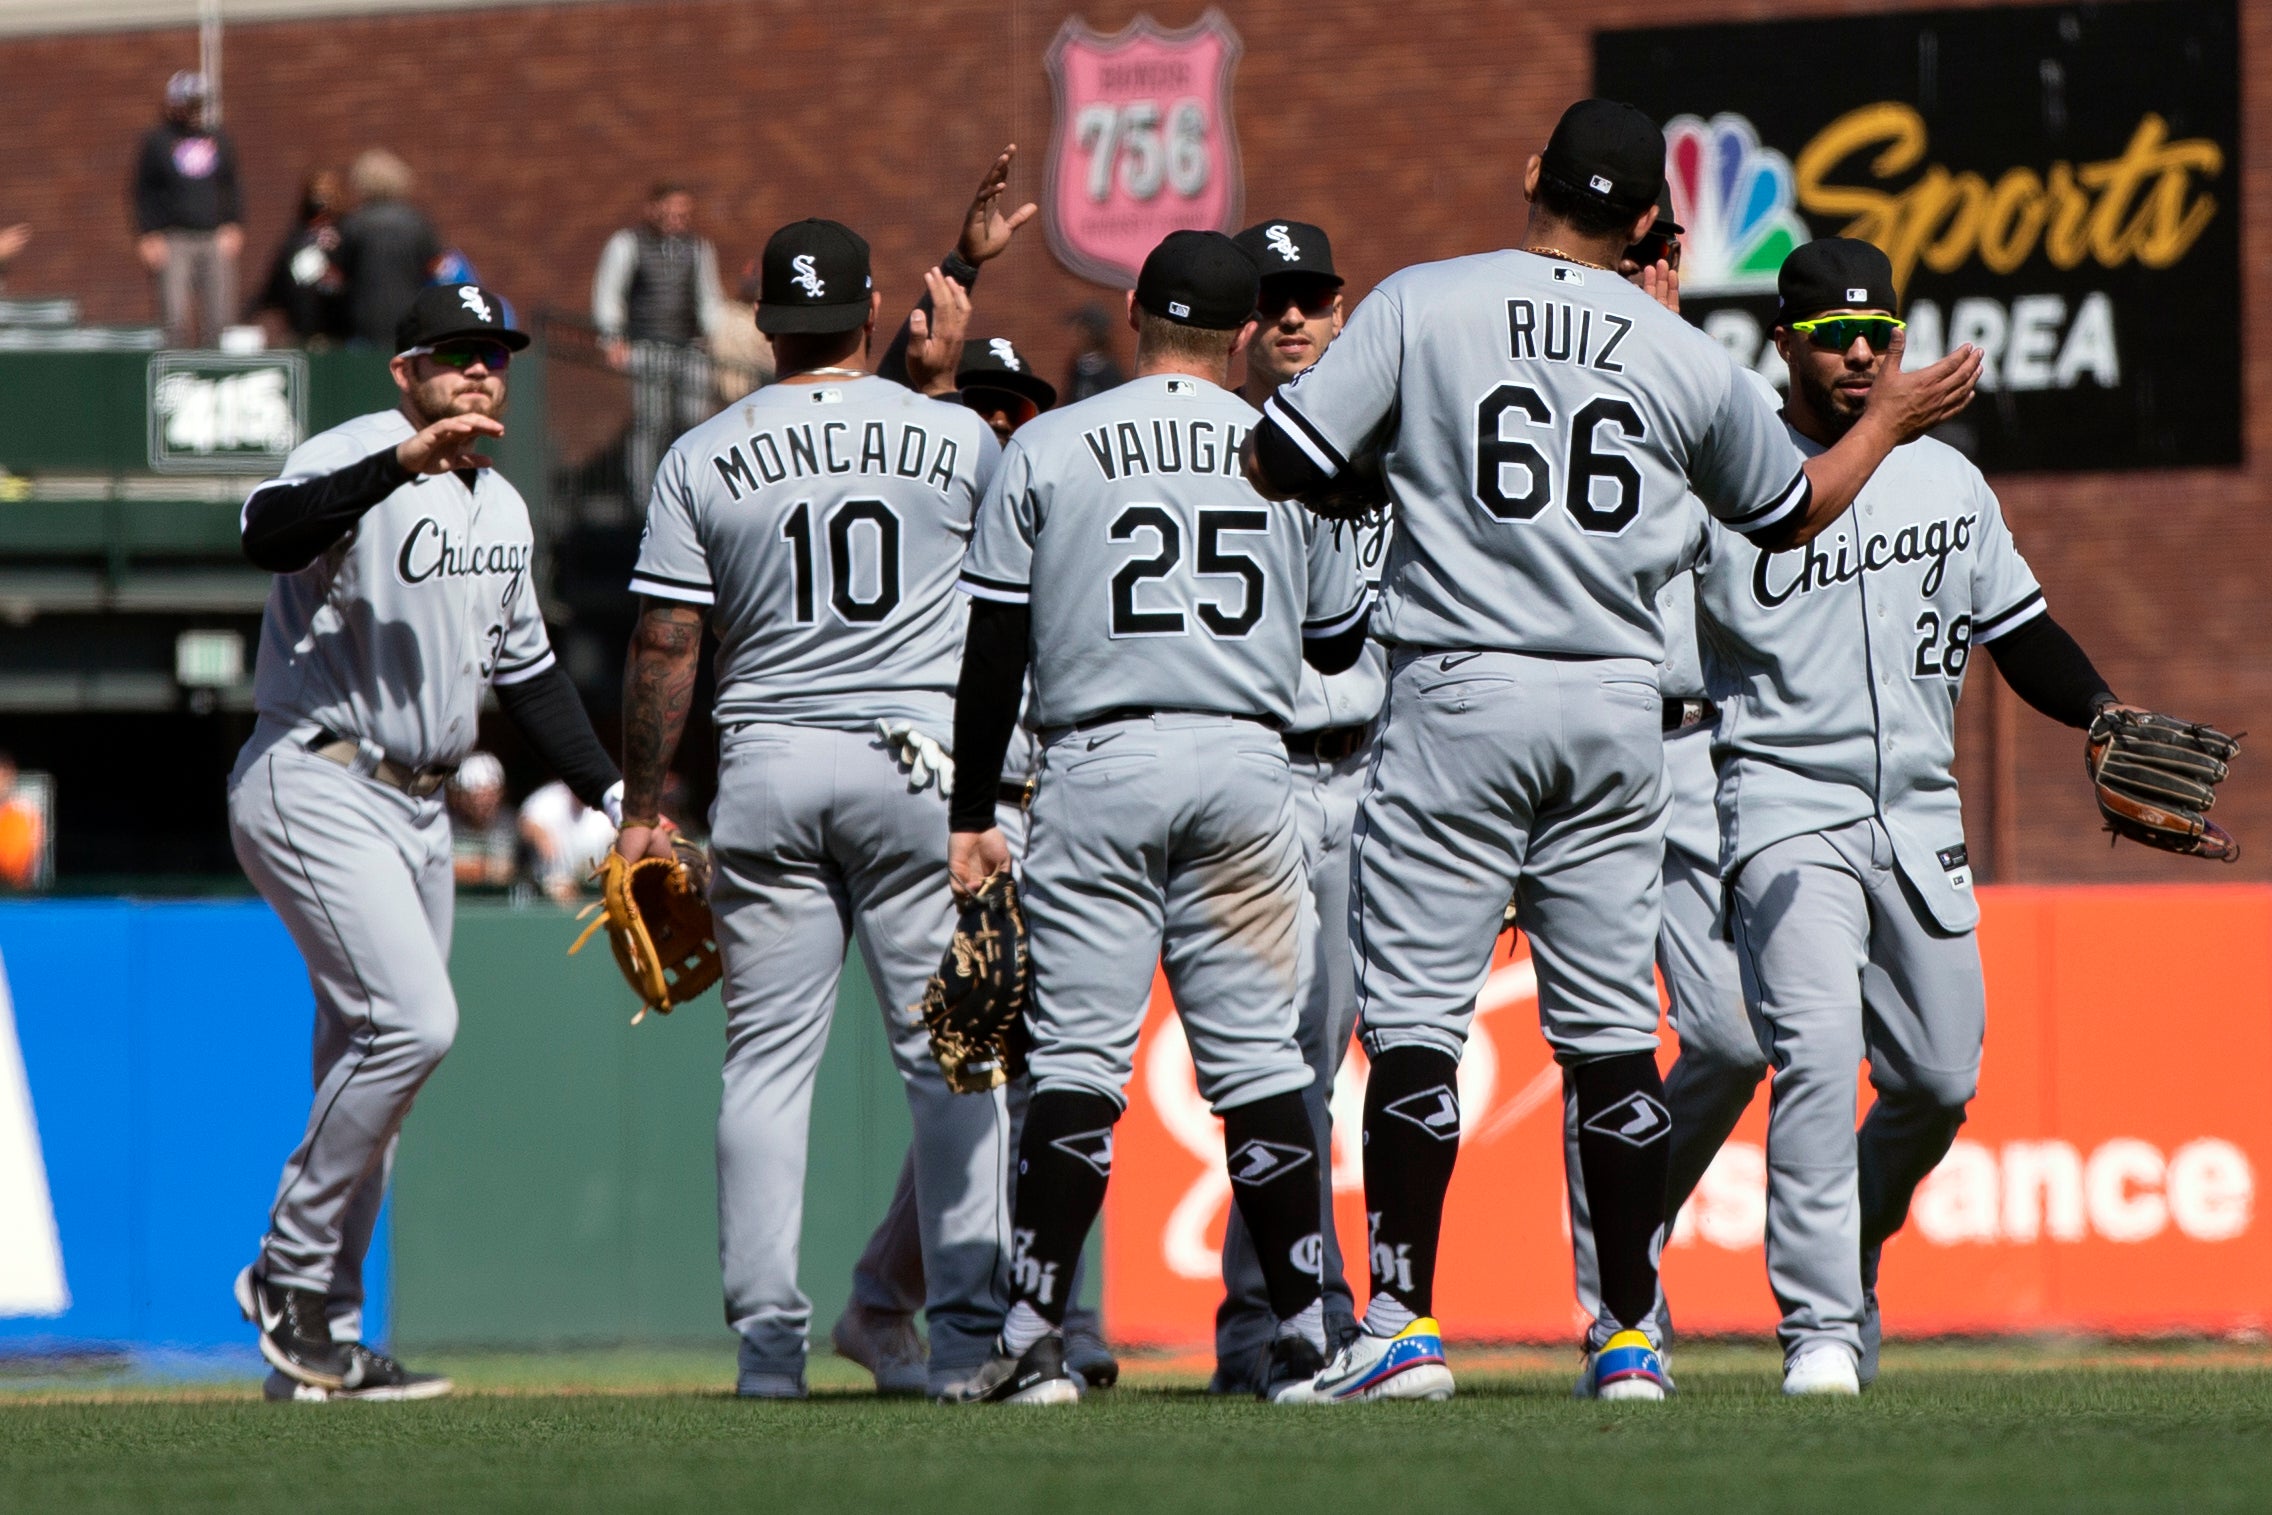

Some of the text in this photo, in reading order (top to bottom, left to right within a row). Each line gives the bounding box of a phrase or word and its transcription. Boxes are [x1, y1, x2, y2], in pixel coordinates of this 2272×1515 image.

[1075, 97, 1211, 202] 756
[1265, 225, 1301, 261] Sox
[1796, 101, 2223, 302] Sports
[791, 254, 825, 297] Sox
[1504, 297, 1635, 375] RUIZ
[1901, 291, 2121, 392] AREA
[711, 418, 959, 502] MONCADA
[1081, 418, 1253, 481] VAUGH
[1472, 380, 1649, 537] 66
[395, 515, 530, 609] Chicag
[779, 496, 904, 628] 10
[1106, 501, 1270, 641] 25
[1751, 511, 1979, 610] Chicago
[1911, 608, 1972, 680] 28
